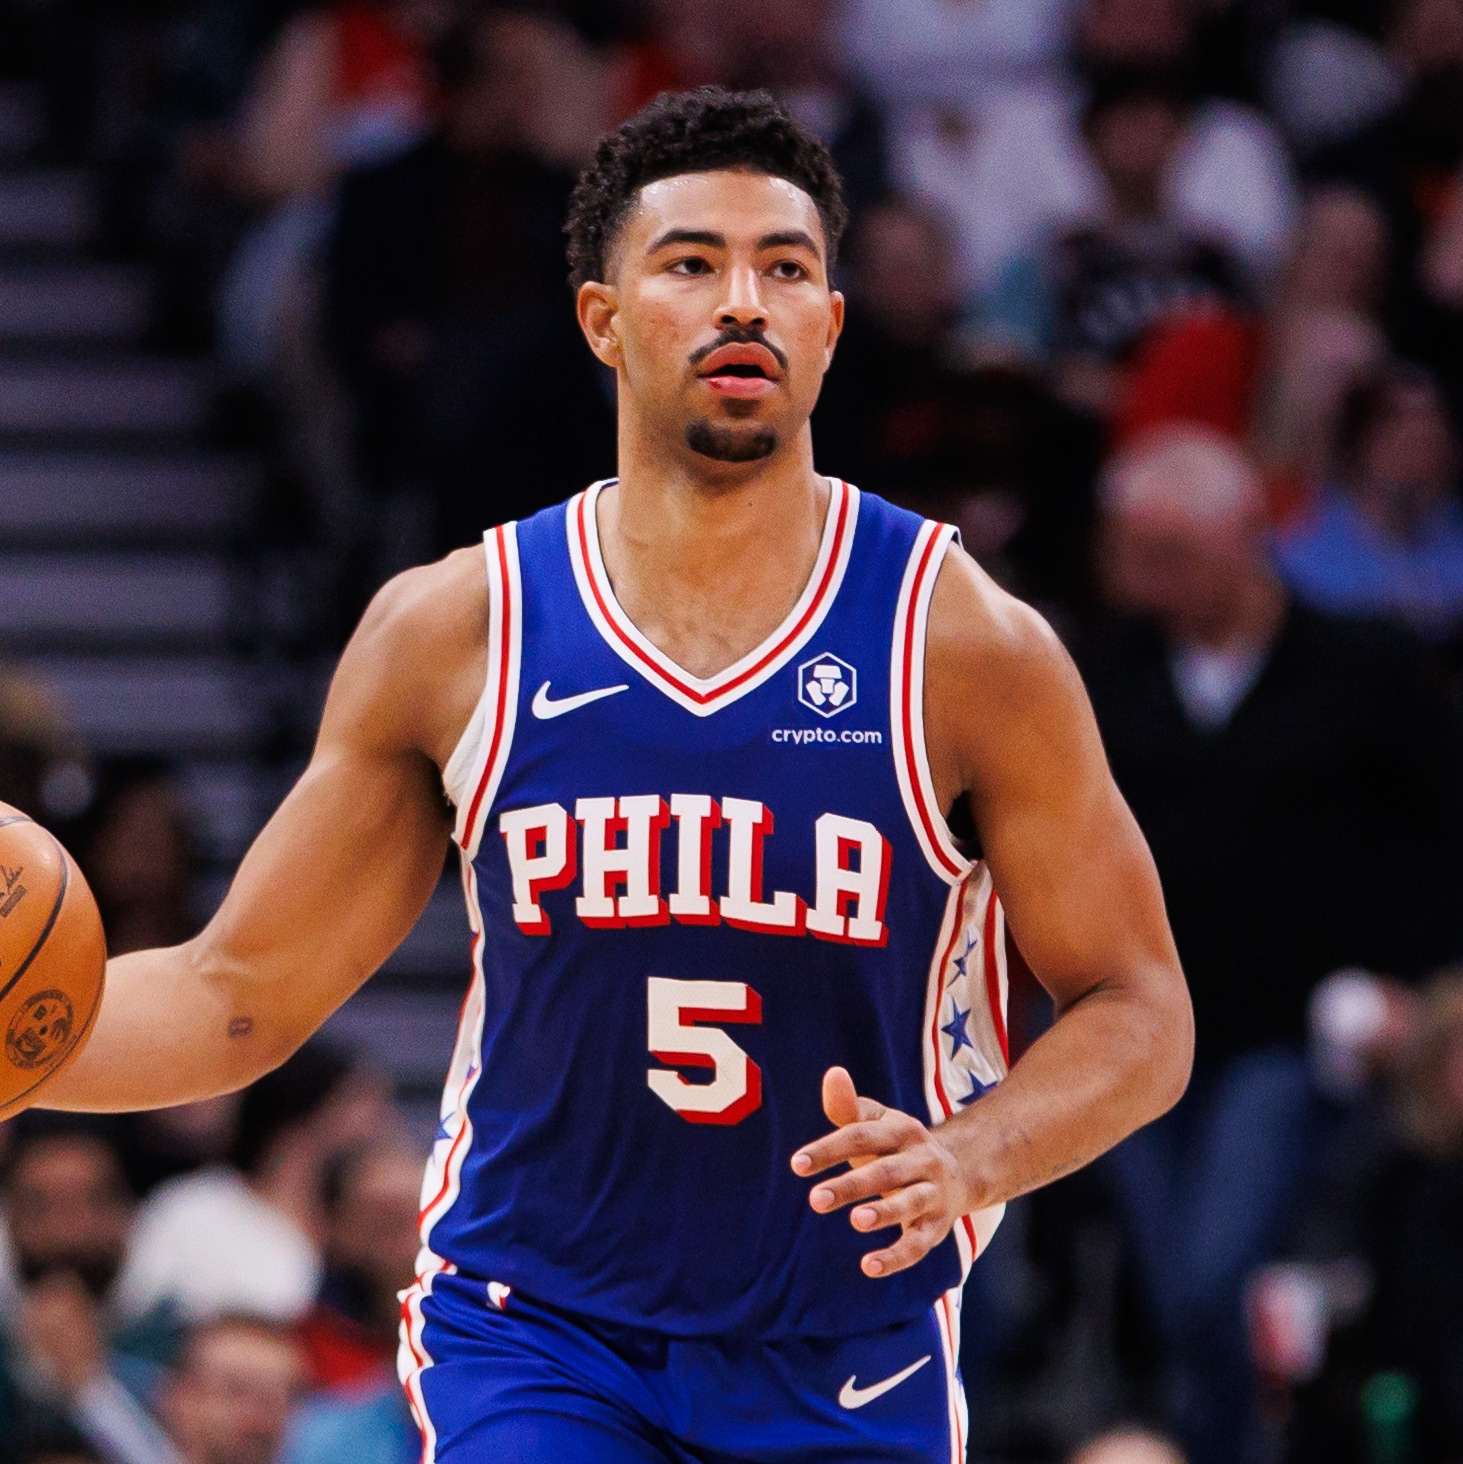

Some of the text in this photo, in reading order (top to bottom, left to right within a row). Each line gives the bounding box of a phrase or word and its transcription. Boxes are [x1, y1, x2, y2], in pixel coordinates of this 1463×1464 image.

[771, 727, 883, 745] crypto.com
[499, 793, 892, 947] PHILA
[646, 976, 762, 1126] 5
